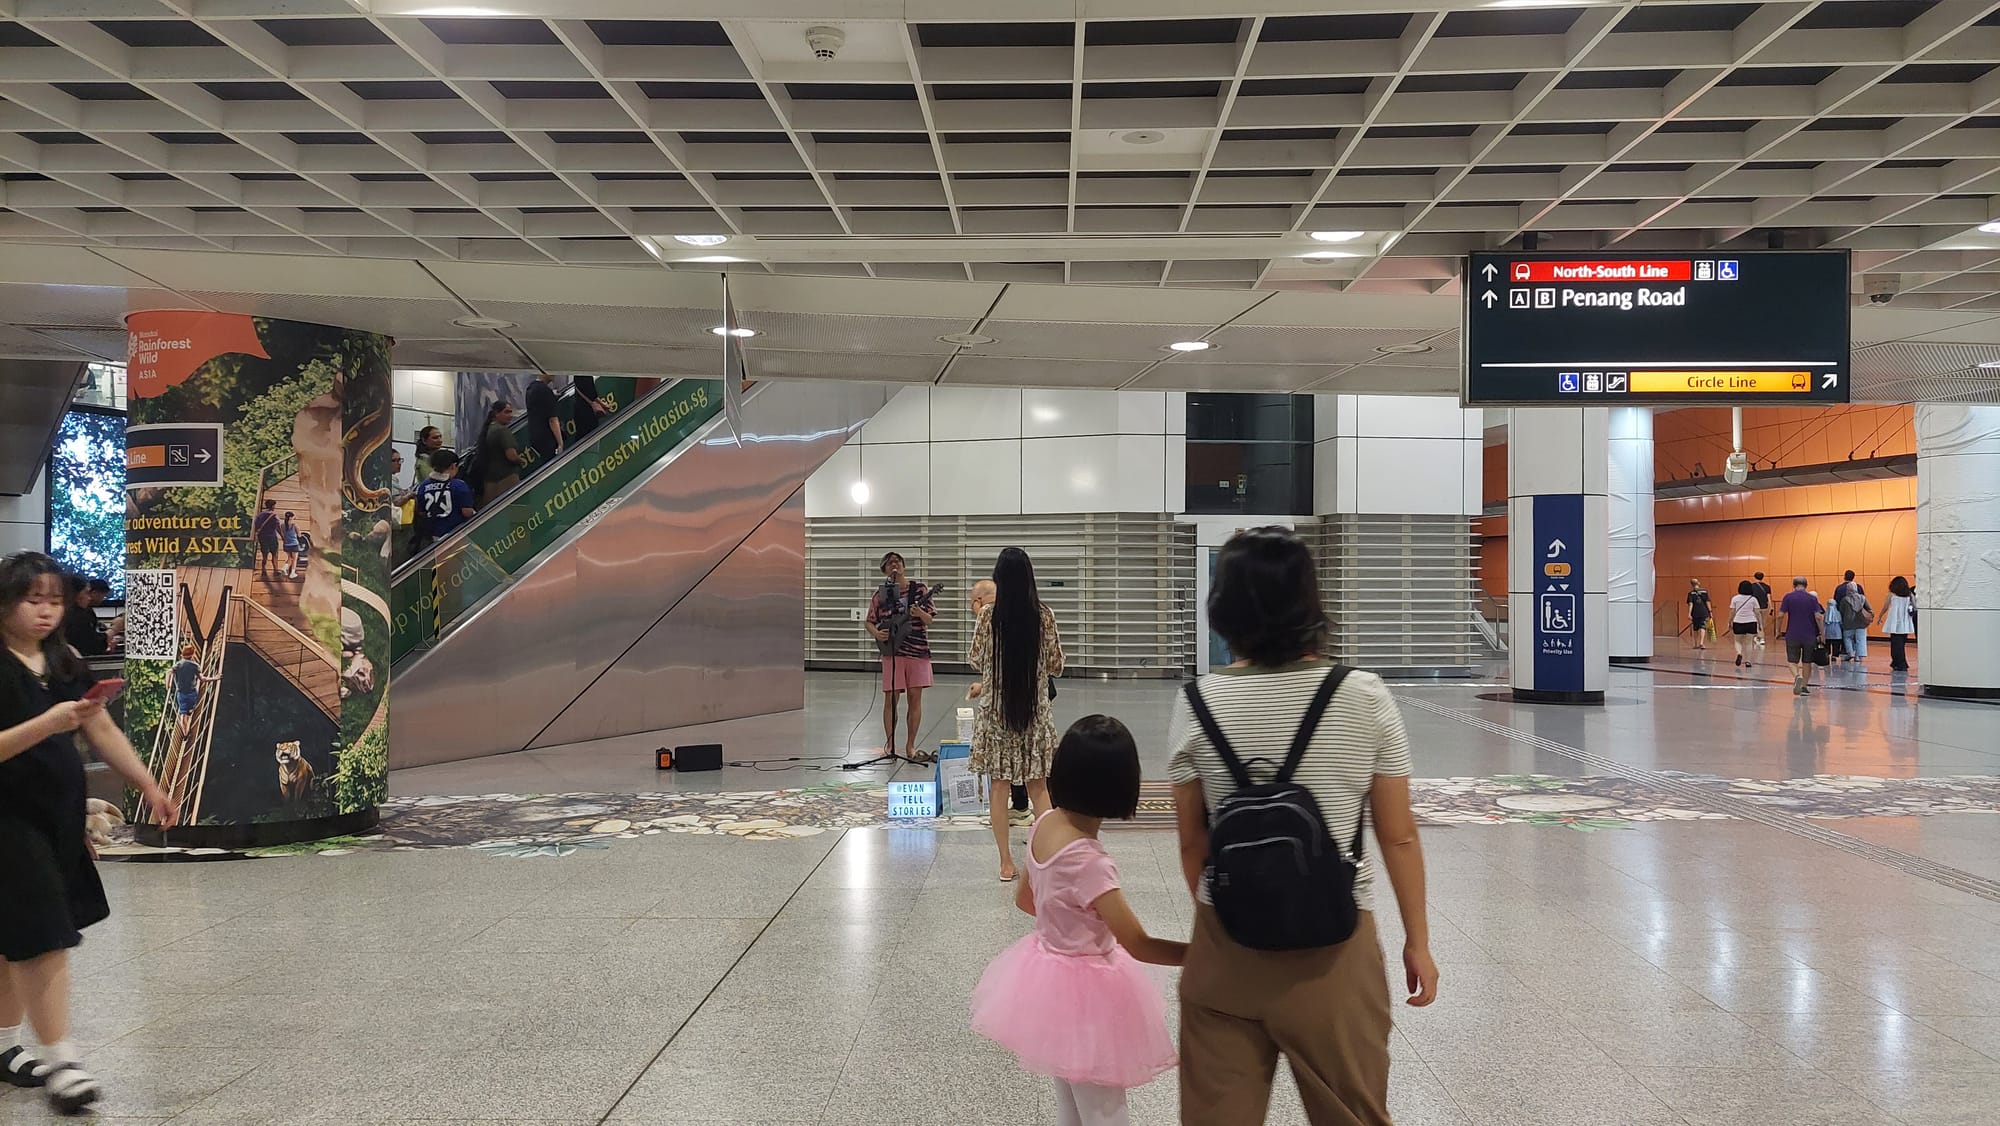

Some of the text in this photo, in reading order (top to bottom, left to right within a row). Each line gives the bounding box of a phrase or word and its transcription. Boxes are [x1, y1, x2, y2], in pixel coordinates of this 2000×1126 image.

[1553, 265, 1668, 279] North-South Line
[1562, 289, 1633, 310] Penang
[1638, 287, 1686, 306] Road
[139, 338, 192, 352] Rainforest
[139, 352, 158, 364] Wild
[139, 370, 157, 379] ASIA
[1687, 376, 1757, 389] Circle Line
[131, 452, 147, 464] Line
[451, 525, 526, 587] adventure
[527, 511, 544, 531] at
[544, 386, 708, 518] rainforestwildasia.sg
[132, 514, 212, 530] adventure
[218, 515, 242, 529] at
[144, 537, 180, 553] Wild
[185, 537, 239, 553] ASIA
[903, 796, 924, 804] TELL
[893, 807, 931, 816] STORIES
